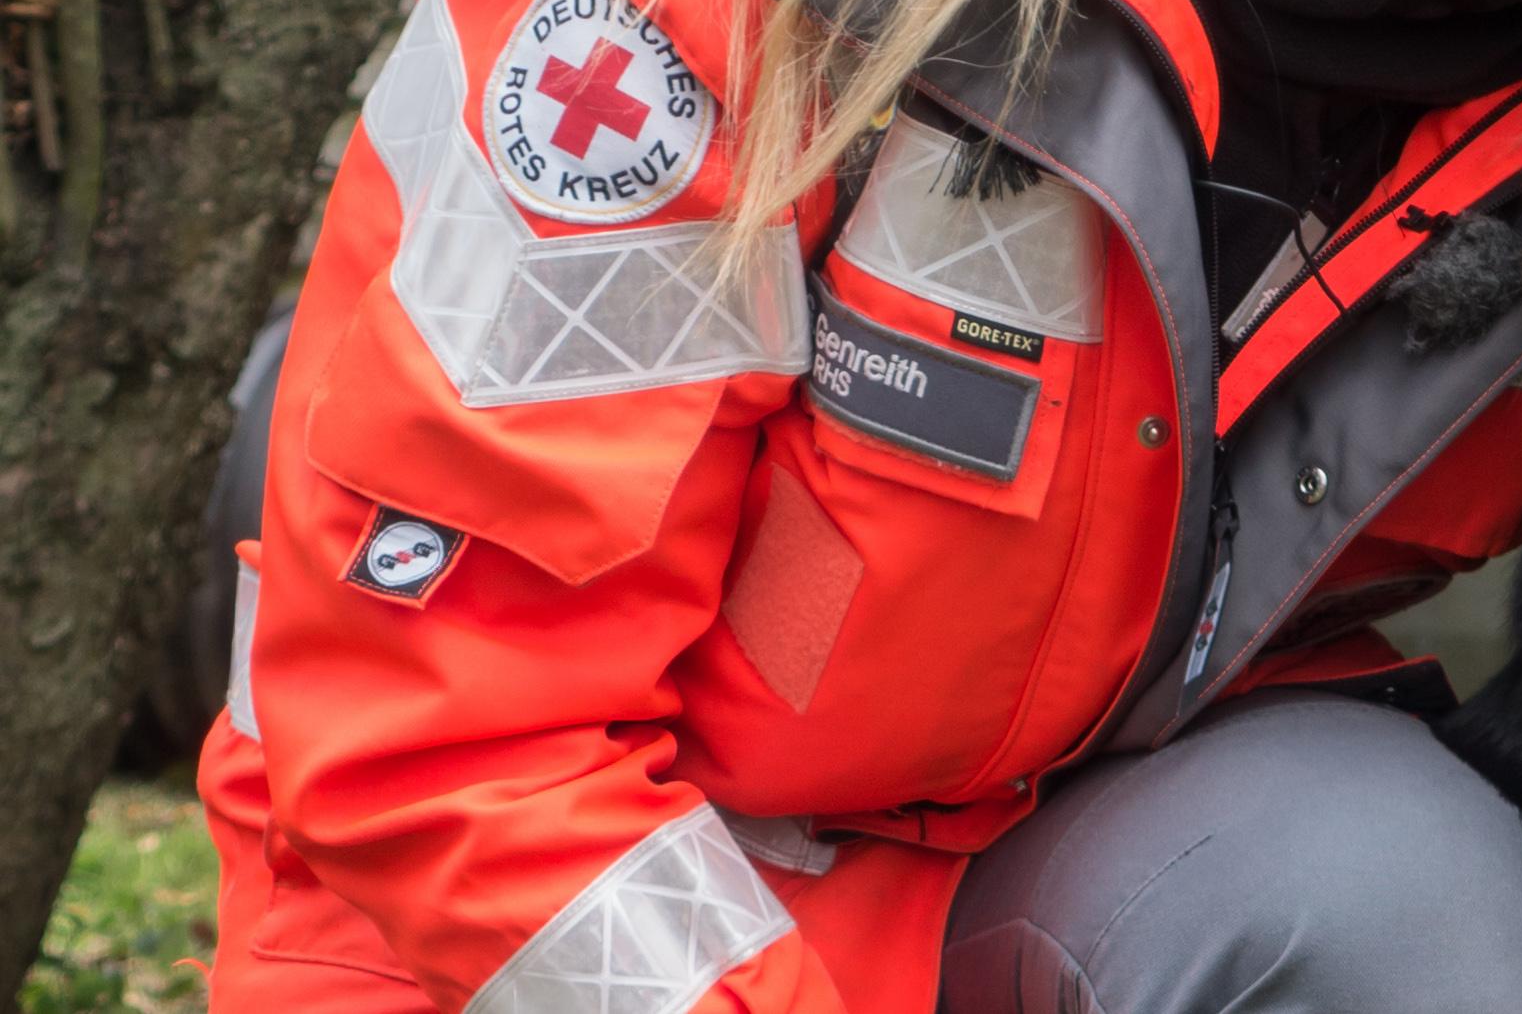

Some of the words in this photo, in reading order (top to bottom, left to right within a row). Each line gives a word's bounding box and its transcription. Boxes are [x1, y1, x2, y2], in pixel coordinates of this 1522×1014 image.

[499, 66, 547, 183] ROTES
[558, 140, 681, 203] KREUZ
[813, 353, 852, 397] RHS
[815, 312, 927, 398] Genreith
